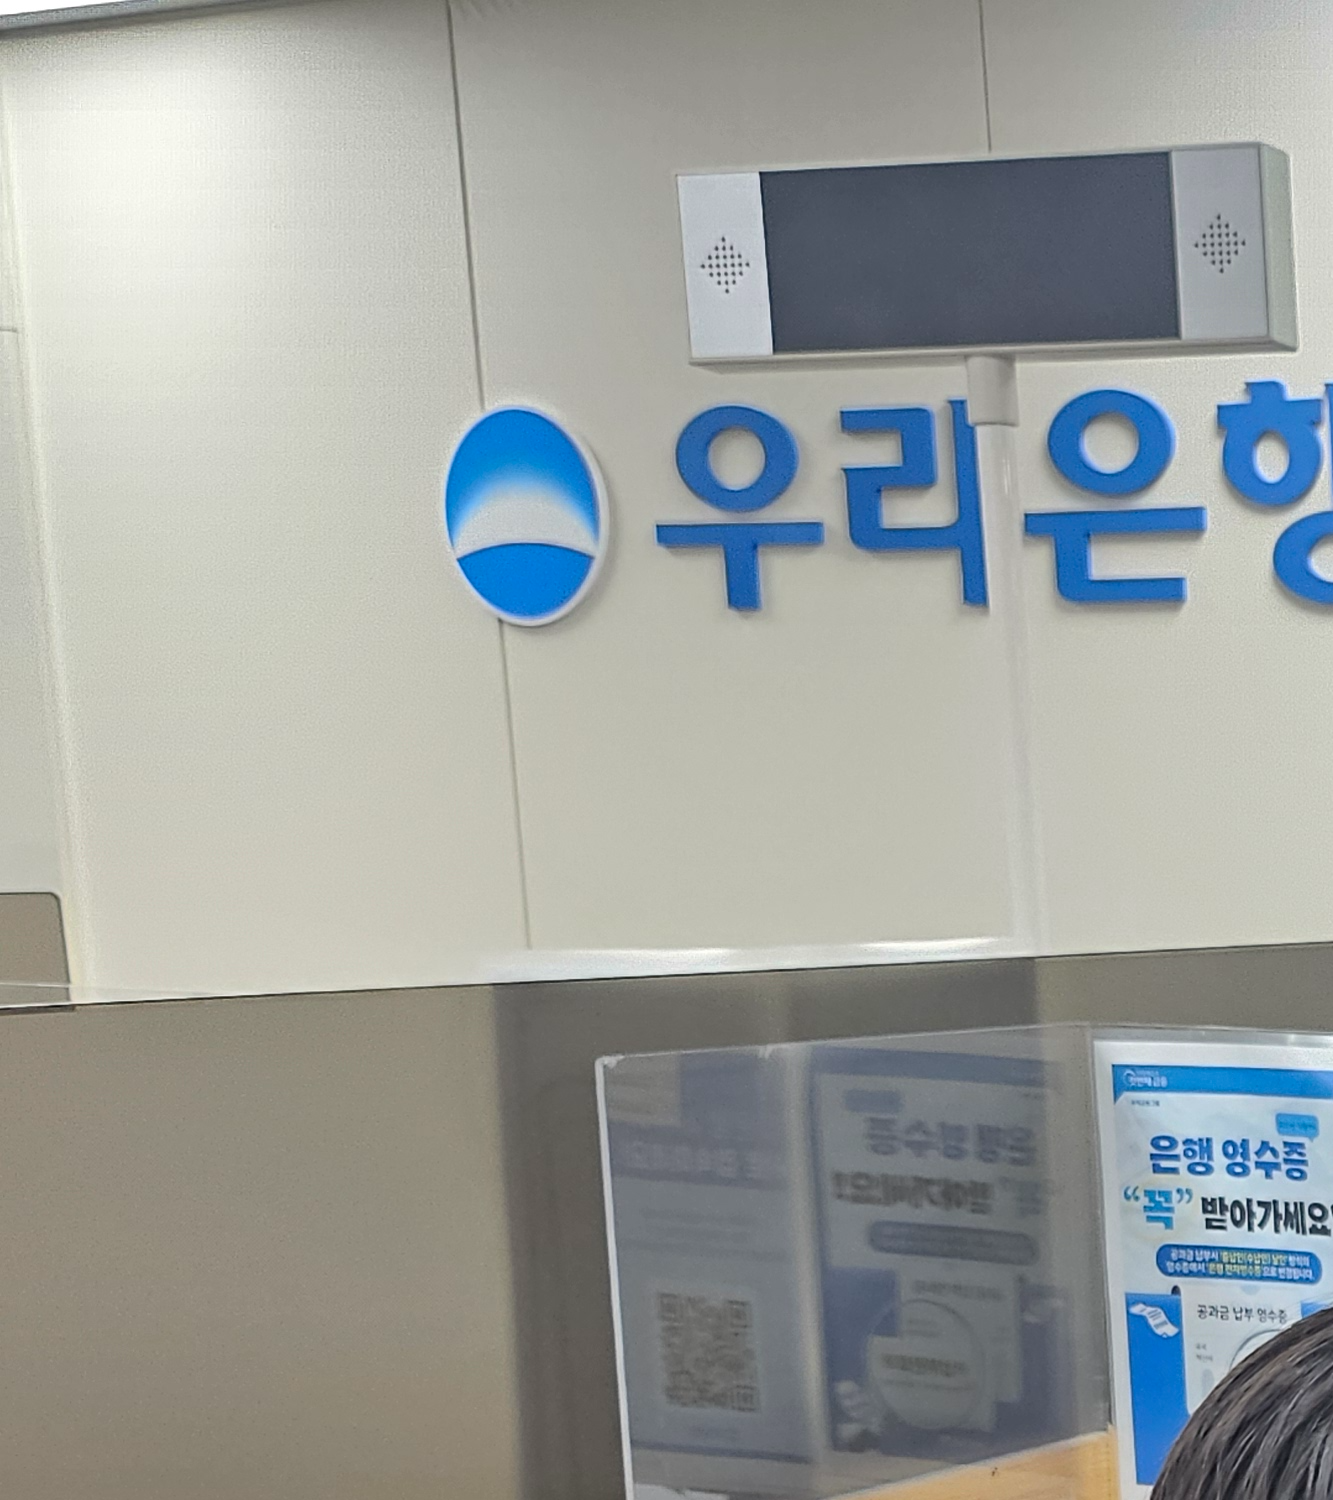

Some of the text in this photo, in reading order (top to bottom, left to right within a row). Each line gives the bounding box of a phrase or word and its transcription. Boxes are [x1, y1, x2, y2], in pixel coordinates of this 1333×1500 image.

[1150, 1135, 1309, 1181] 은행 영수증
[1196, 1304, 1288, 1324] 공과금 납부 영수증
